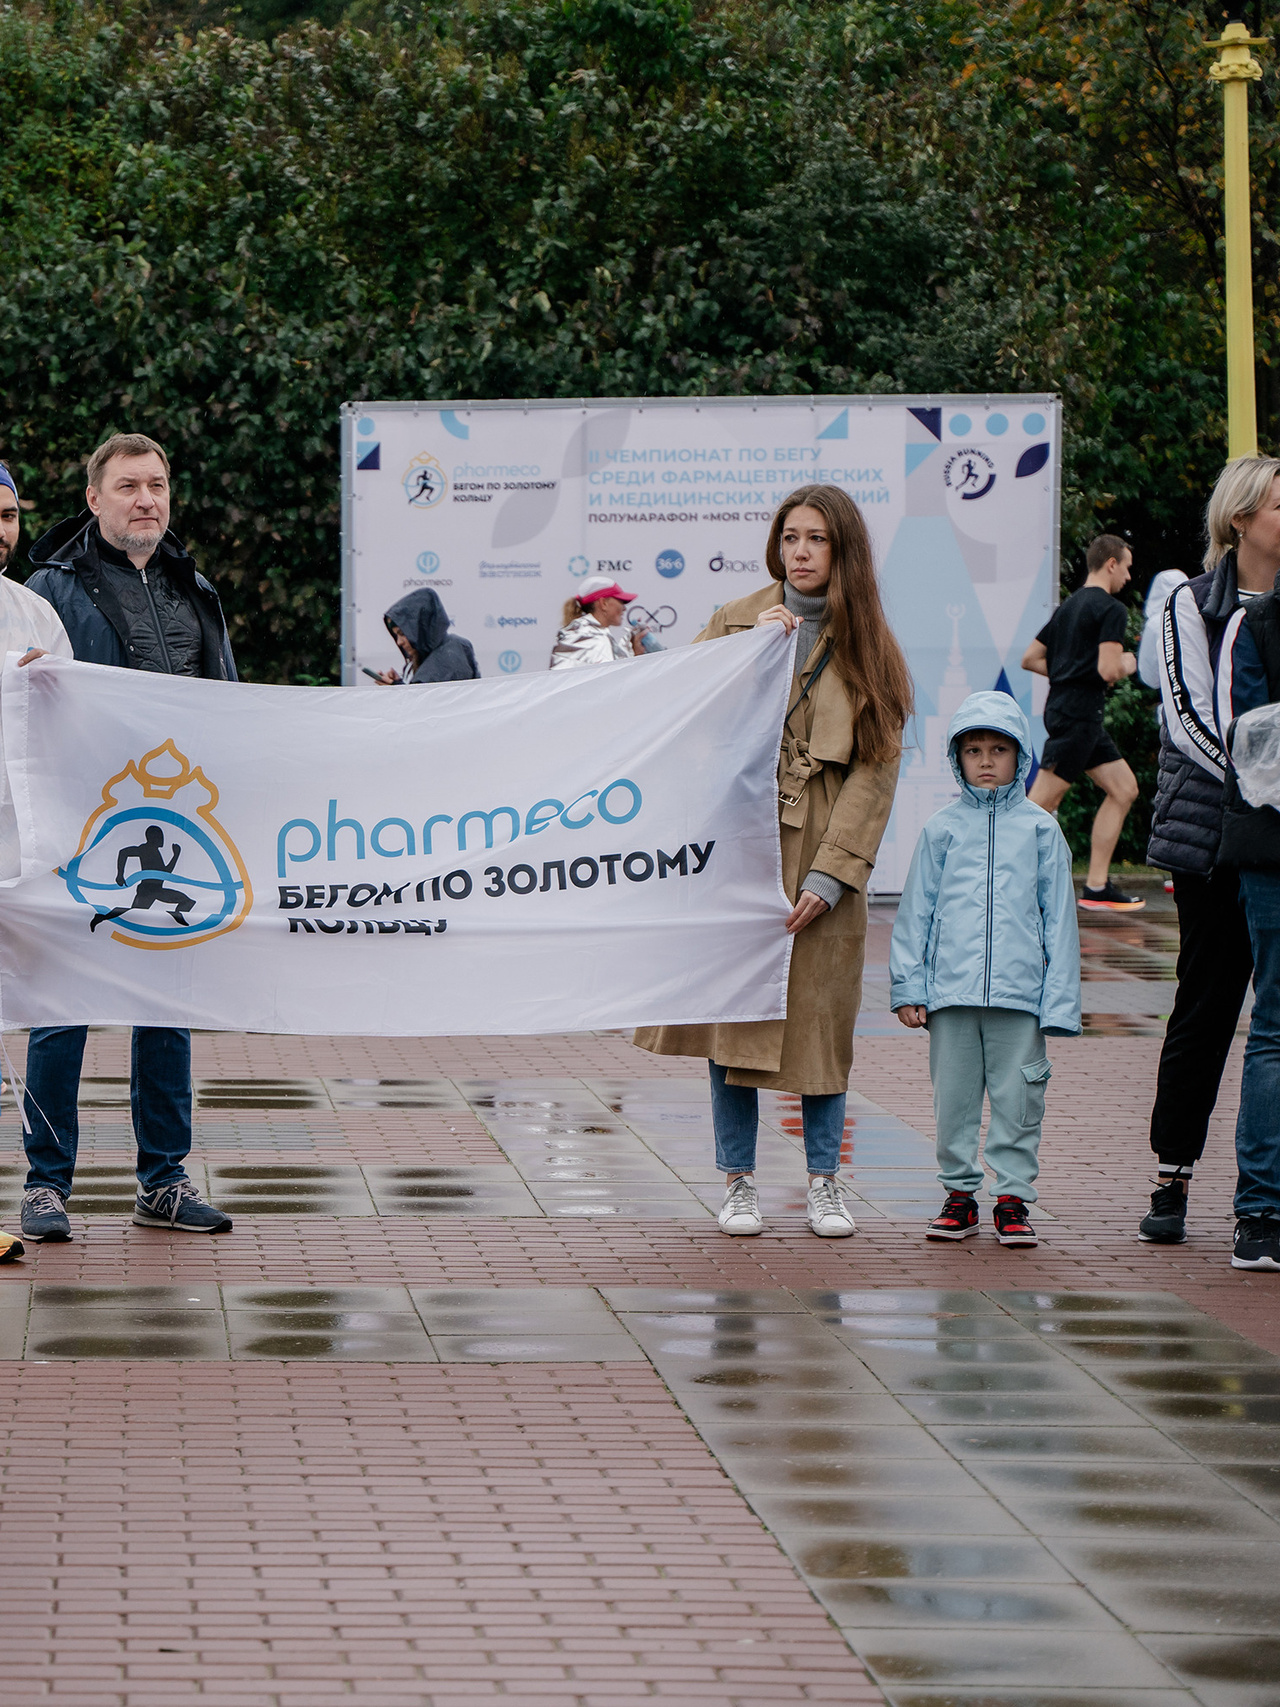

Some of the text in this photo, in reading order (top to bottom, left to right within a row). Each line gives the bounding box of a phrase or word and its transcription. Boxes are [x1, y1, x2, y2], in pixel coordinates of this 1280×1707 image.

[605, 448, 733, 463] ЧЕМПИОНАТ
[738, 448, 768, 462] ПО
[773, 447, 823, 462] БЕГУ
[453, 462, 541, 481] pharmeco
[588, 468, 884, 486] СРЕДИ ФАРМАЦЕВТИЧЕСКИХ
[486, 482, 501, 490] ПО
[453, 494, 493, 503] КОЛЬЦУ
[588, 492, 602, 507] И
[608, 491, 766, 508] МЕДИЦИНСКИХ
[588, 512, 698, 523] ПОЛУМАРАФОН
[596, 559, 633, 572] FMC
[402, 577, 454, 589] pharmeco
[497, 615, 538, 629] ферон
[1180, 711, 1221, 759] ALEXANDER
[276, 778, 643, 879] pharmeco
[278, 840, 717, 909] БЕГОМ ПО ЗОЛОТОМУ
